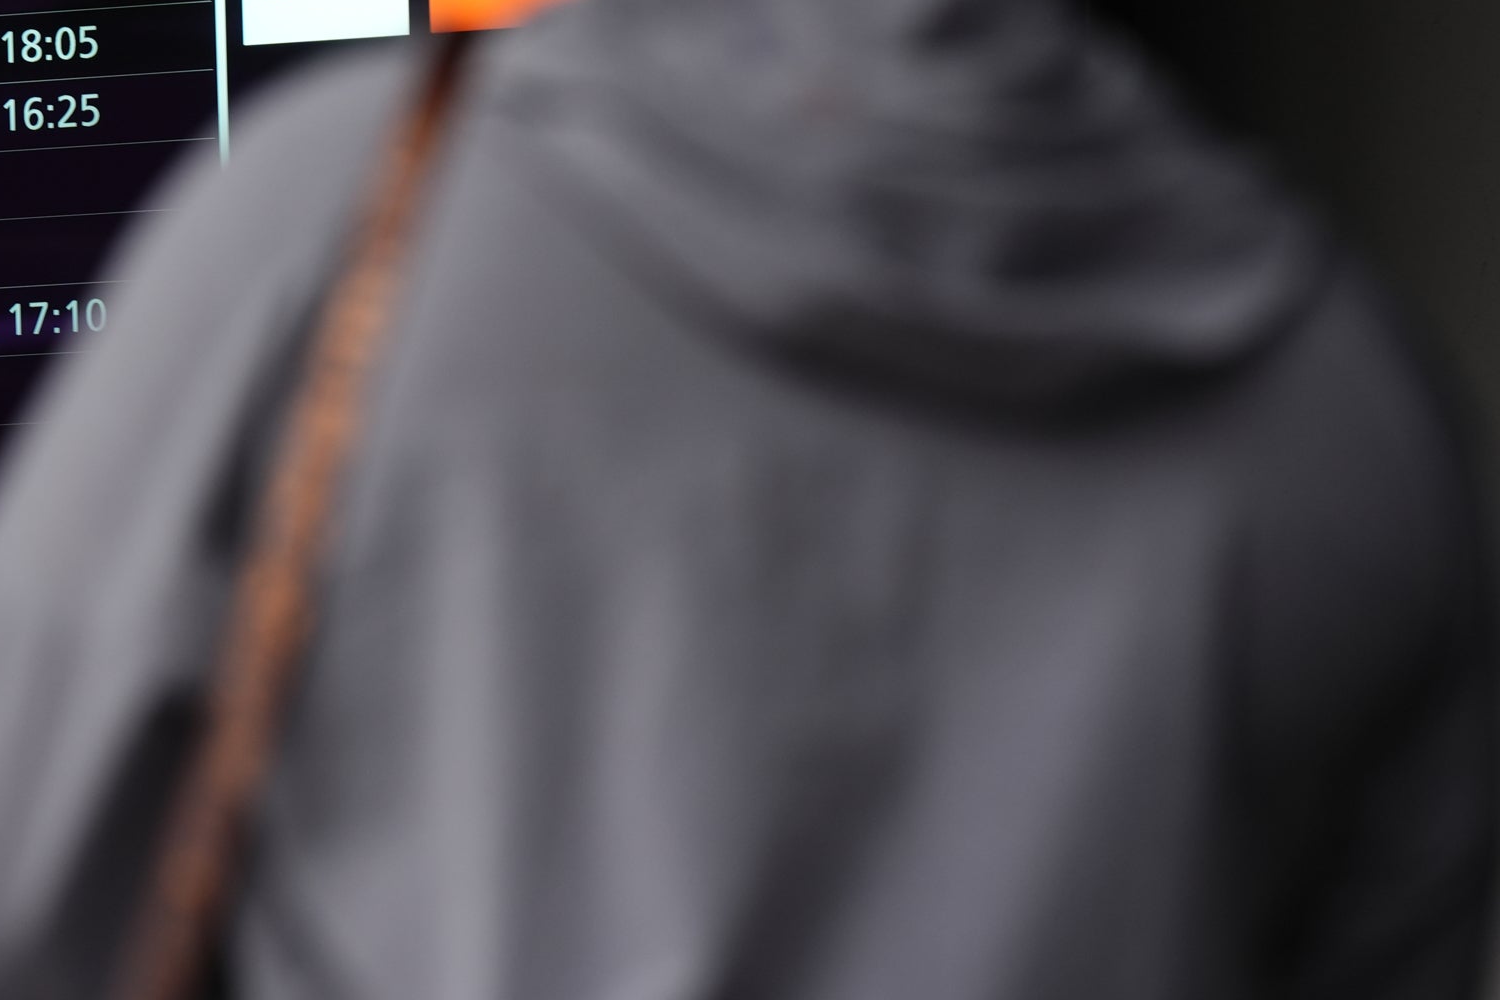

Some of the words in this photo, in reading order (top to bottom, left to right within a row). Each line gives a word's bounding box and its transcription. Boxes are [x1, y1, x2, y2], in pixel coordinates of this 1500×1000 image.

[0, 24, 99, 64] 18:05
[2, 92, 101, 132] 16:25
[8, 298, 107, 336] 17:10
